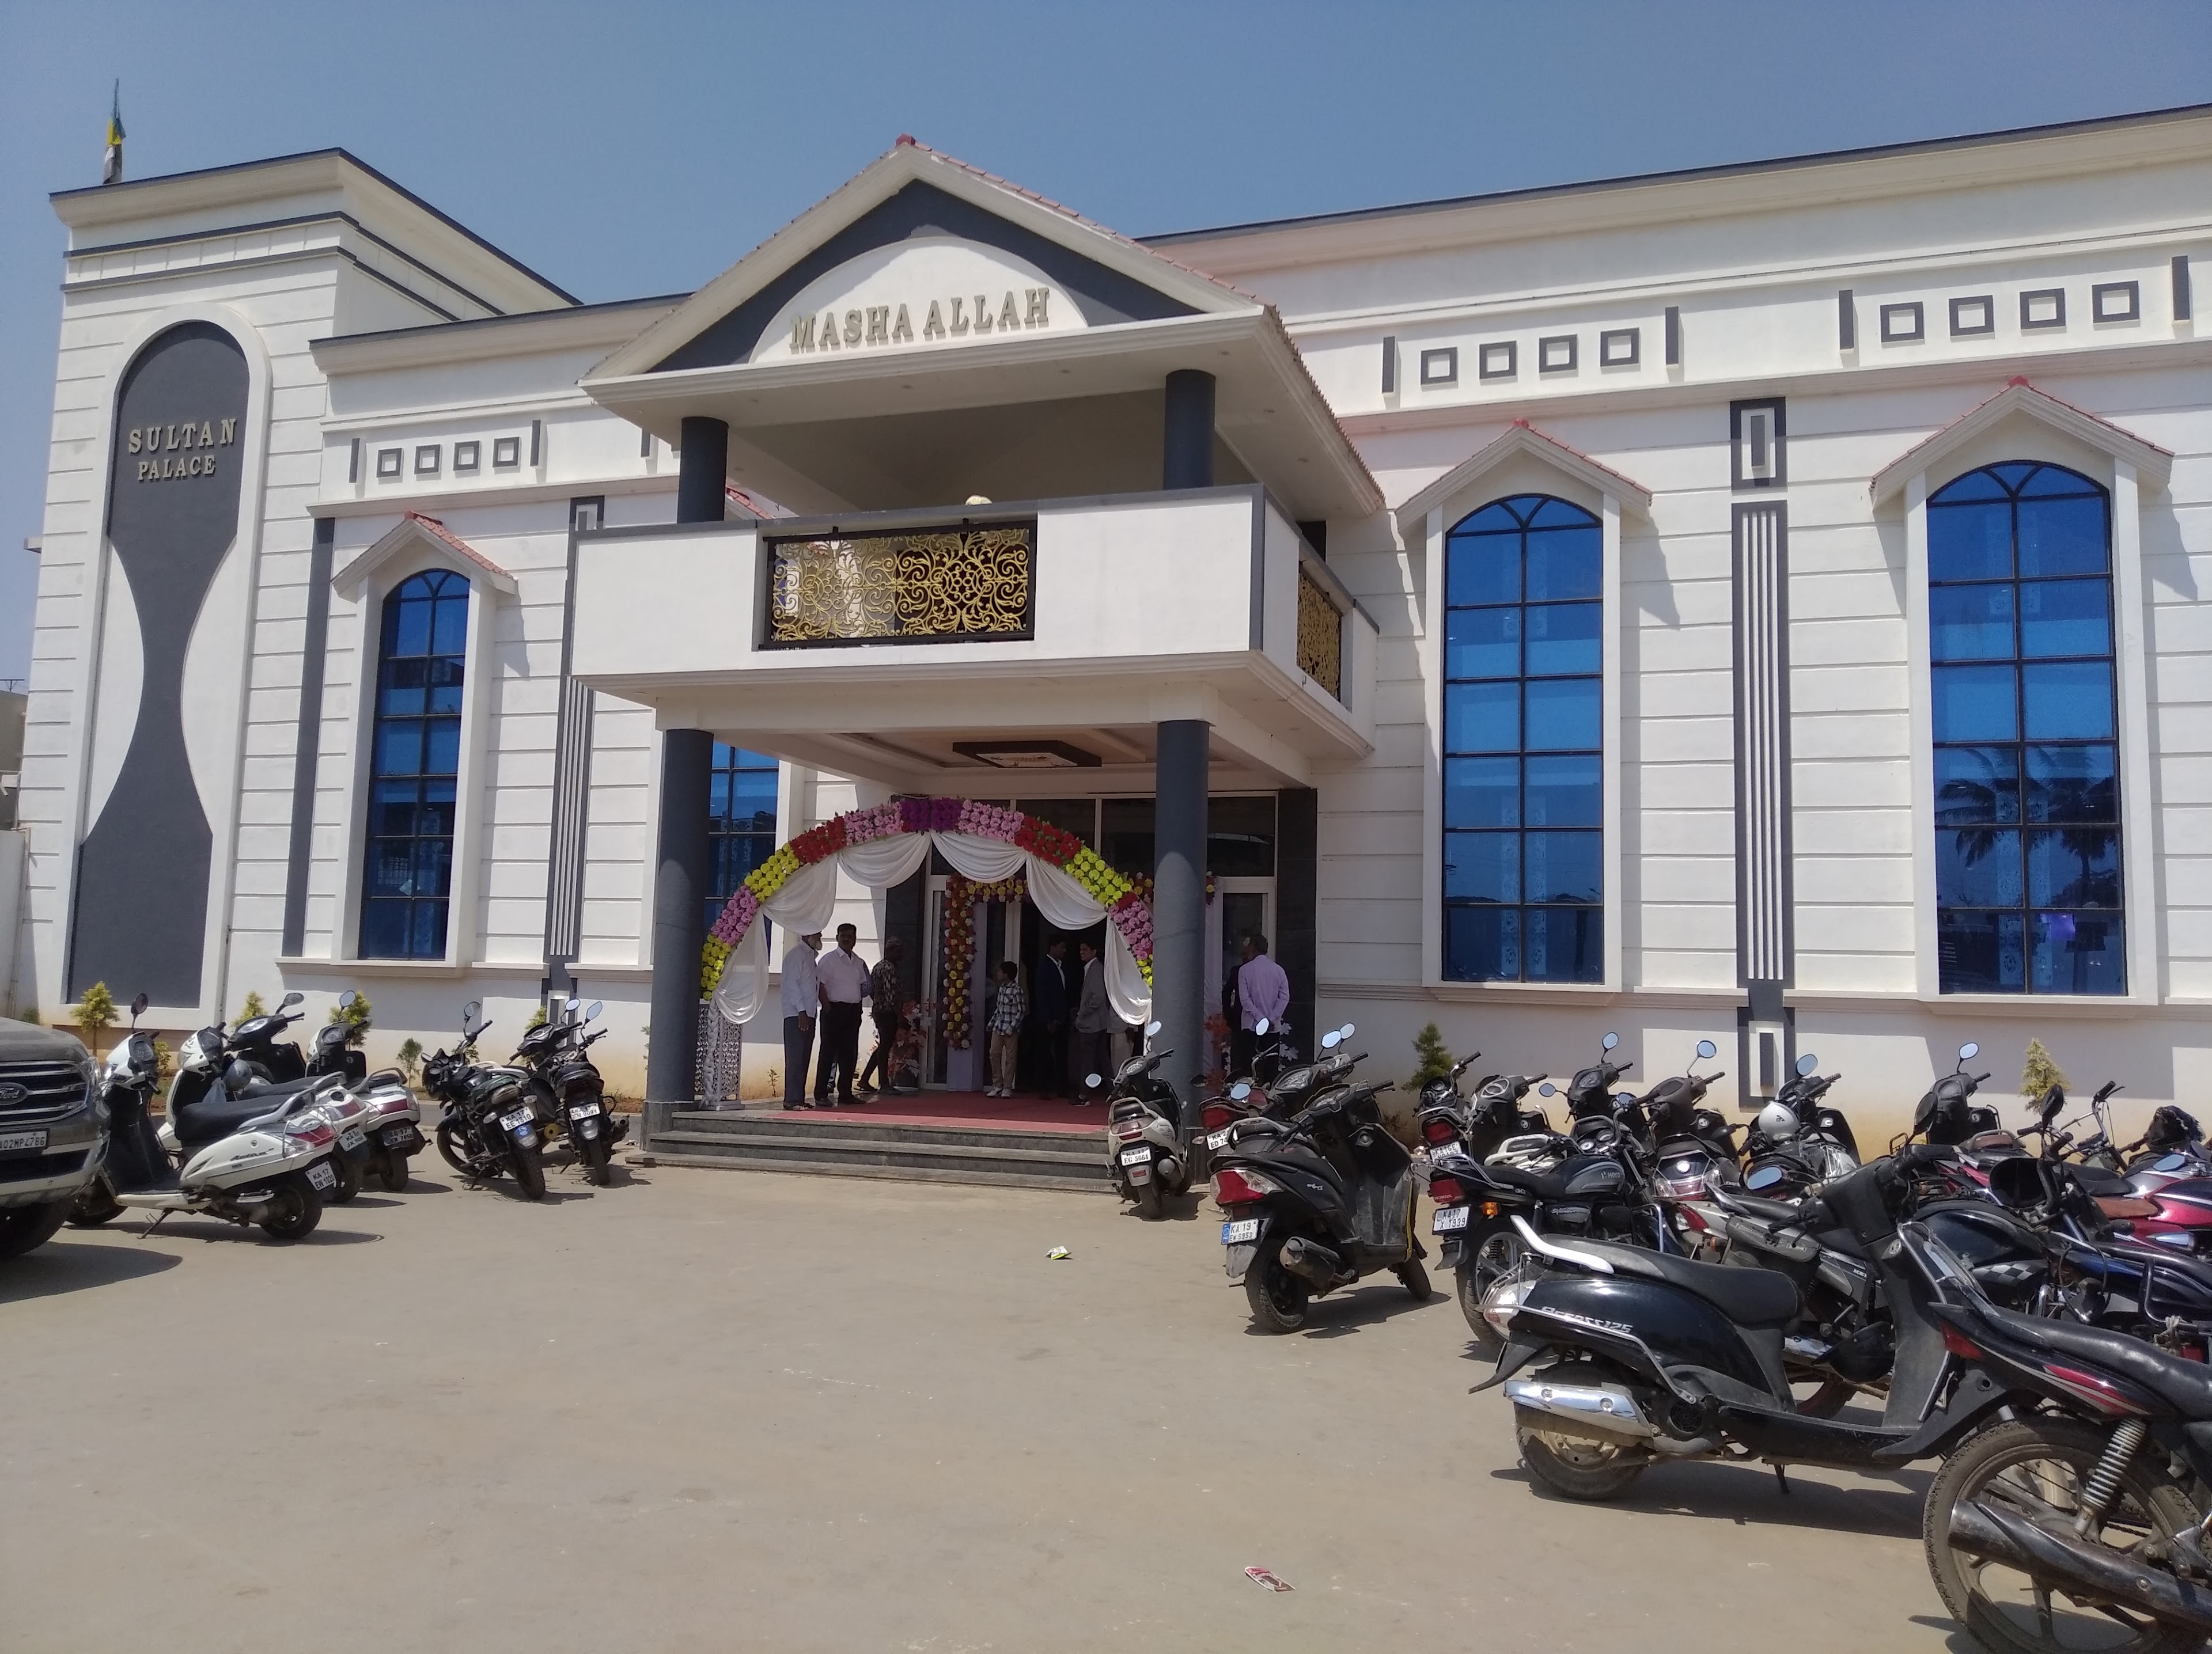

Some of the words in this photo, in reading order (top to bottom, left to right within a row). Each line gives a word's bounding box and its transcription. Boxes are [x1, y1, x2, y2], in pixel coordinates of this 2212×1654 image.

[789, 303, 913, 350] MASHA
[923, 287, 1050, 335] ALLAH
[128, 419, 236, 454] SULTAN
[138, 455, 216, 481] PALACE
[506, 1121, 516, 1129] EE
[516, 1114, 532, 1124] 1810
[315, 1179, 324, 1189] EW
[1230, 1224, 1240, 1234] KA
[1243, 1222, 1251, 1231] 19
[1440, 1220, 1445, 1230] X
[1449, 1217, 1466, 1228] 1939
[1237, 1232, 1252, 1240] 5953
